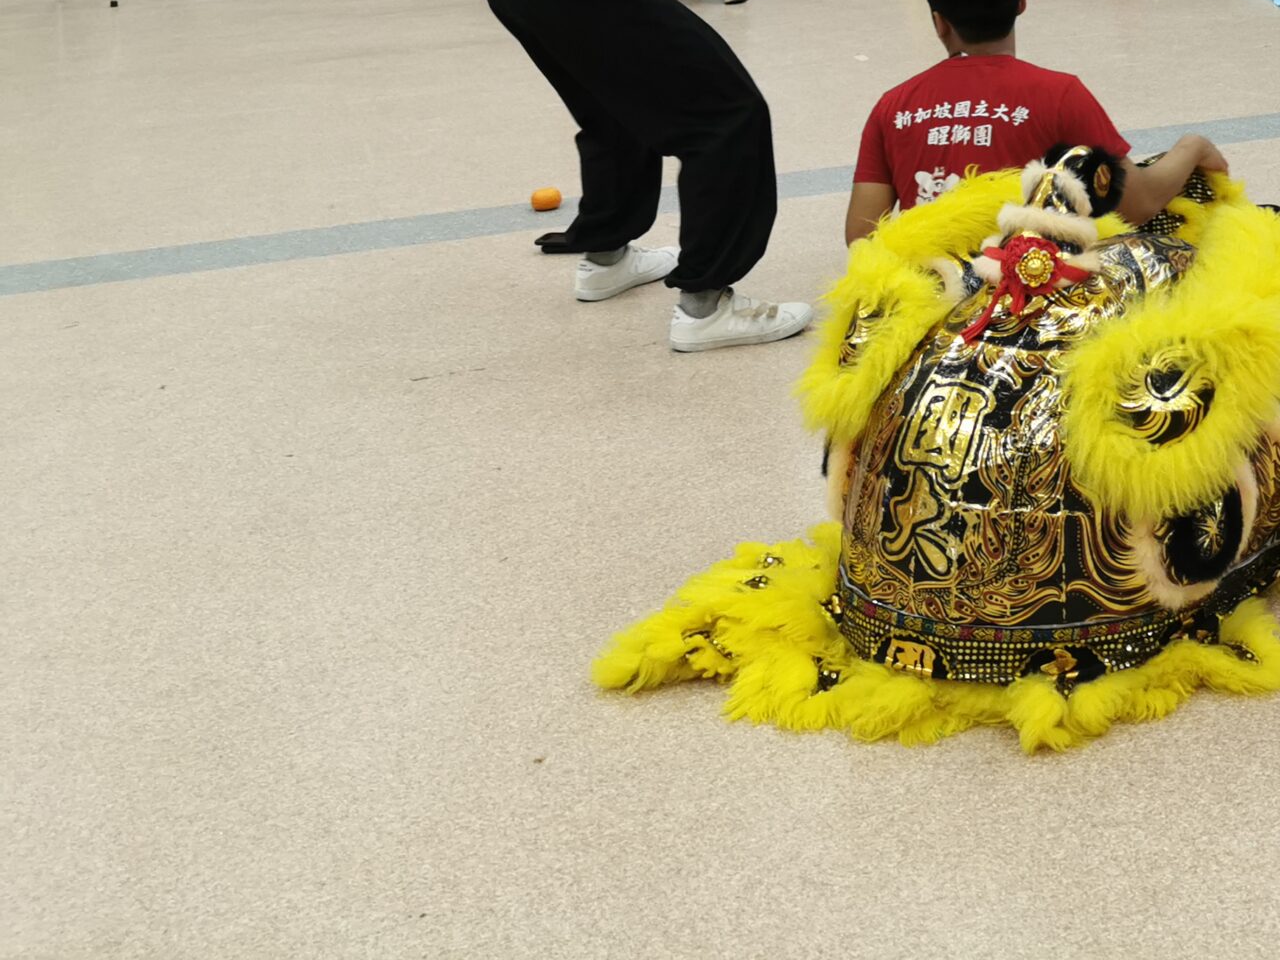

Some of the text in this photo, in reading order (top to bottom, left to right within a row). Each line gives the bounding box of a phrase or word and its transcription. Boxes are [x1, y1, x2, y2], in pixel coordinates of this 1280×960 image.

[893, 100, 1030, 130] 新加坡國立大學
[927, 124, 993, 147] 醒獅團
